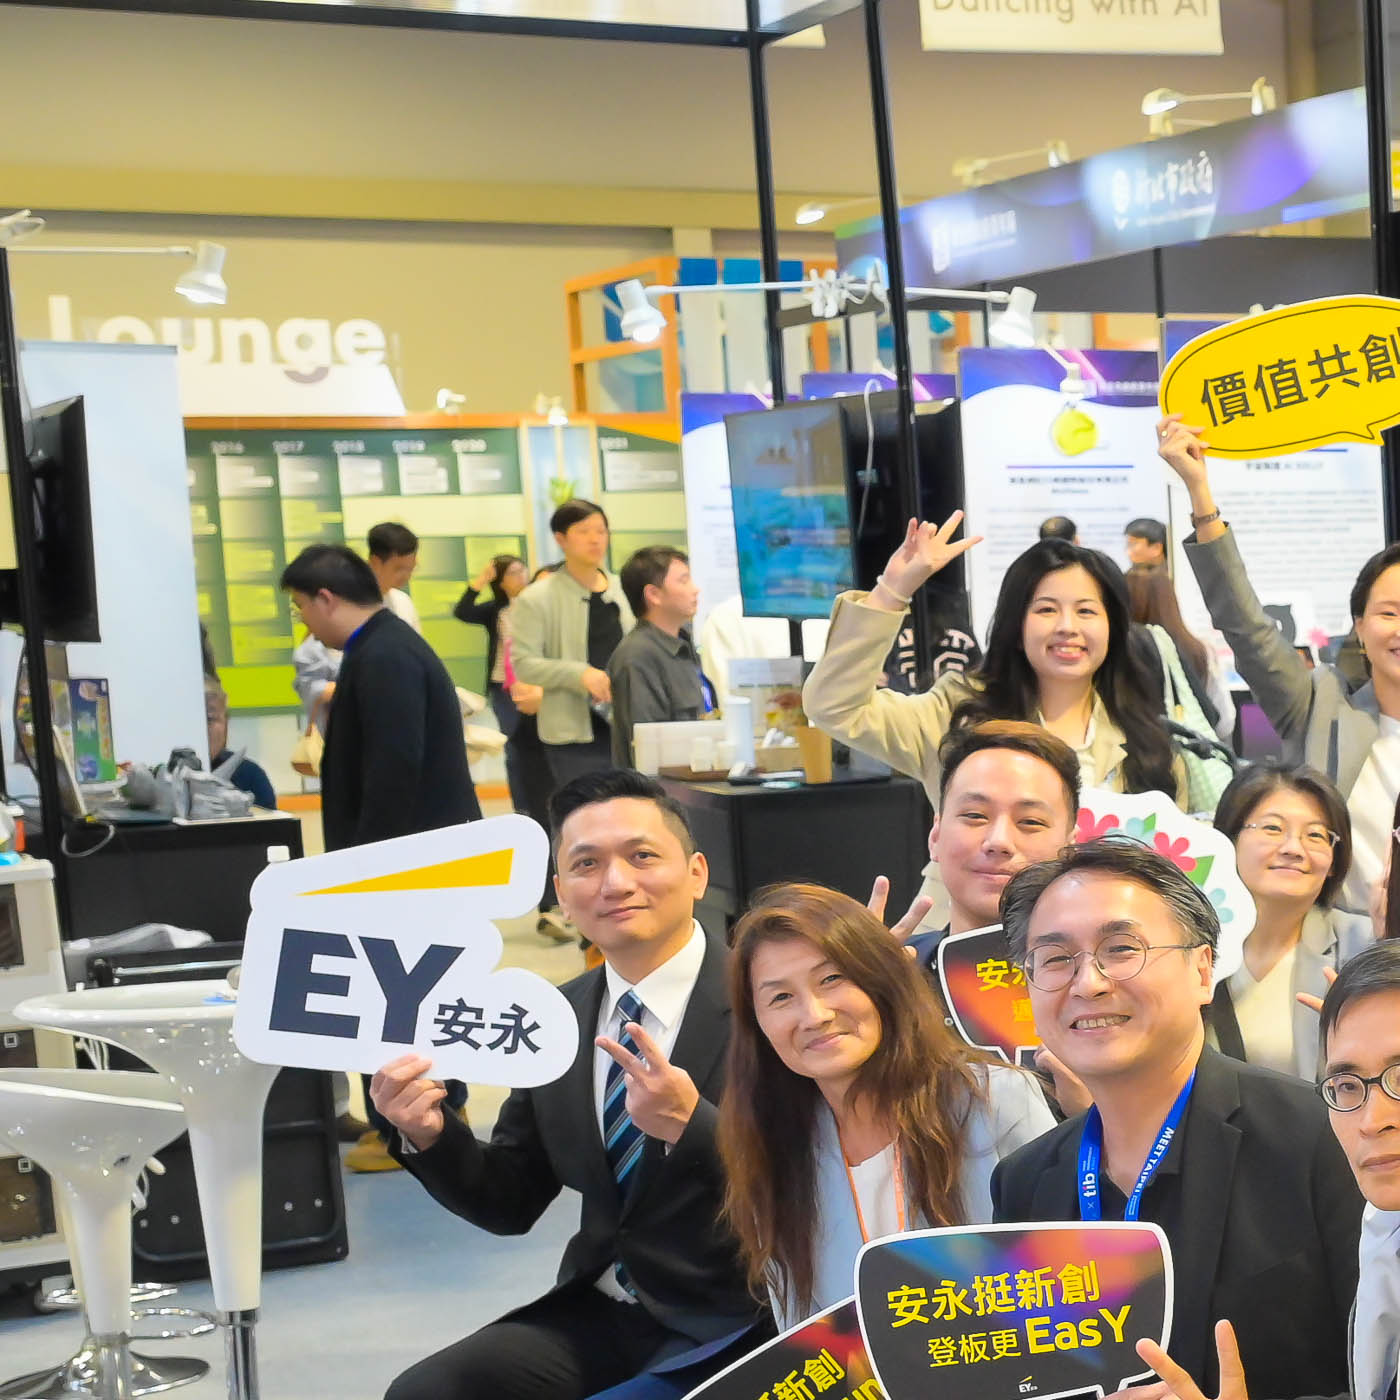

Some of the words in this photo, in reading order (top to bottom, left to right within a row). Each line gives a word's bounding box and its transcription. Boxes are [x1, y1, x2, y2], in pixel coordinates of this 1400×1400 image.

[888, 1260, 1101, 1328] 安永挺新創
